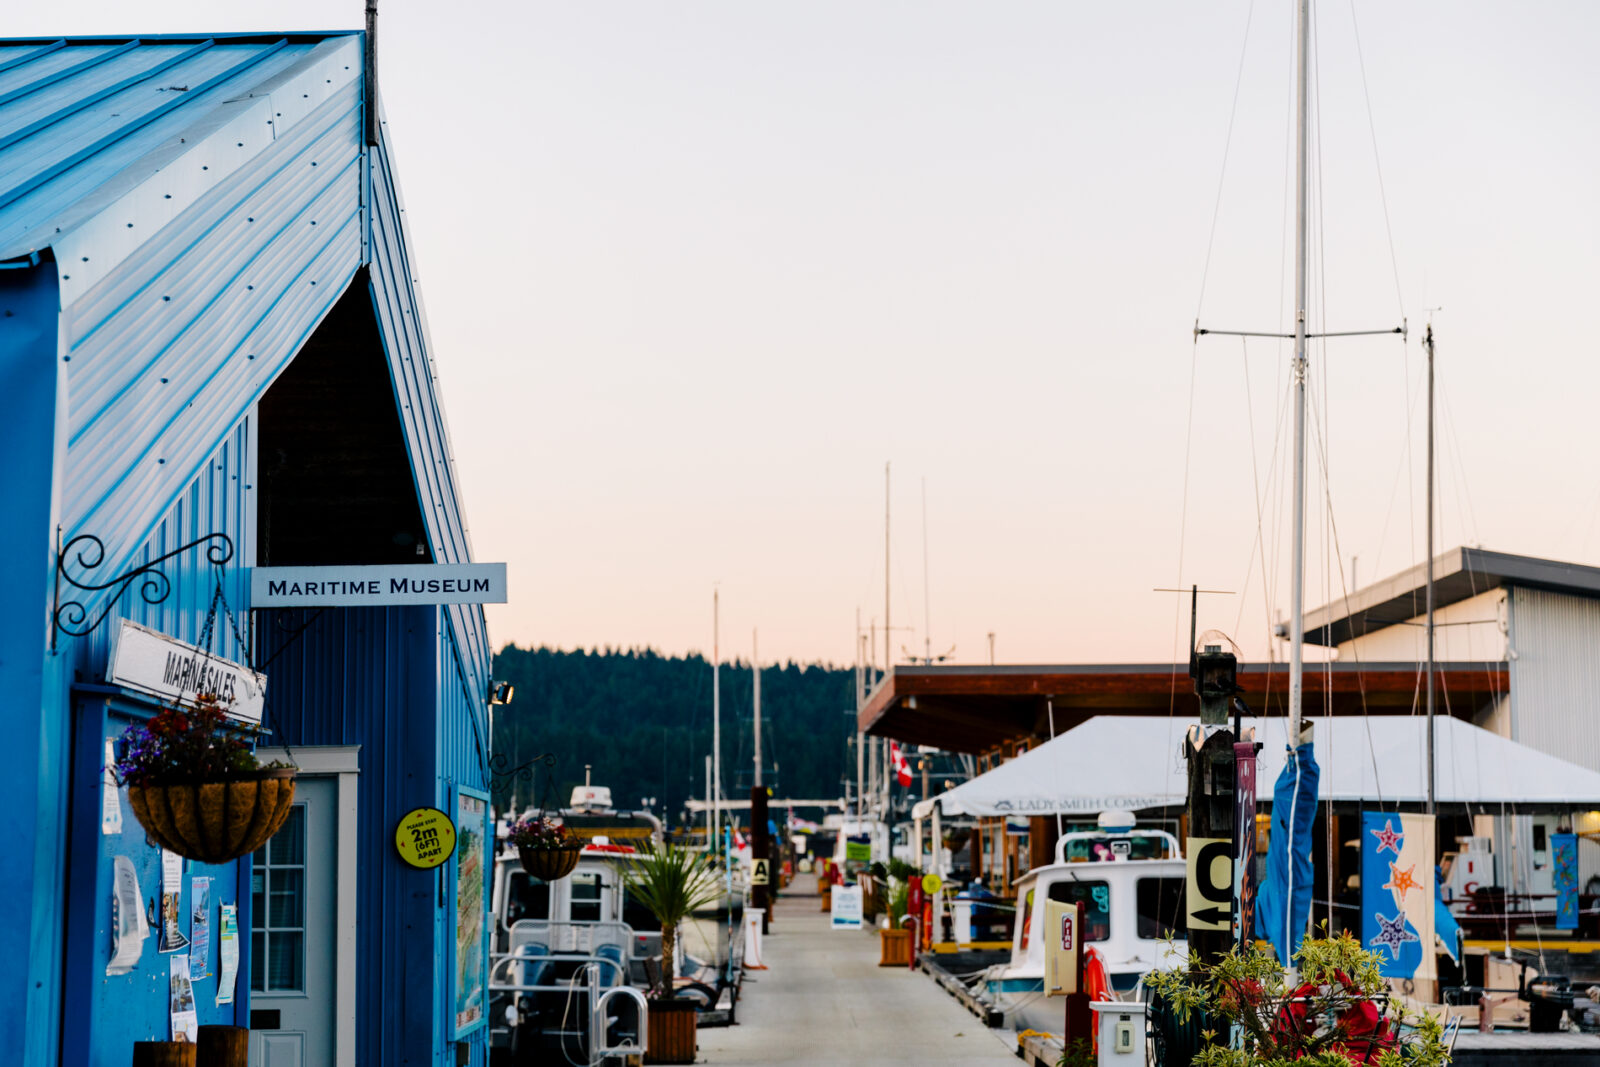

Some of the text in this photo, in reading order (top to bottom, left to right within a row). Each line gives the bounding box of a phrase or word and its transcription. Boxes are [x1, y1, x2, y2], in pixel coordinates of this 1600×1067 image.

[268, 578, 490, 596] MARITIME MUSEUM
[163, 651, 237, 705] MARINA SALES
[411, 828, 438, 842] 2m
[415, 838, 440, 852] (6FT)
[418, 848, 441, 859] APART
[755, 861, 767, 876] A
